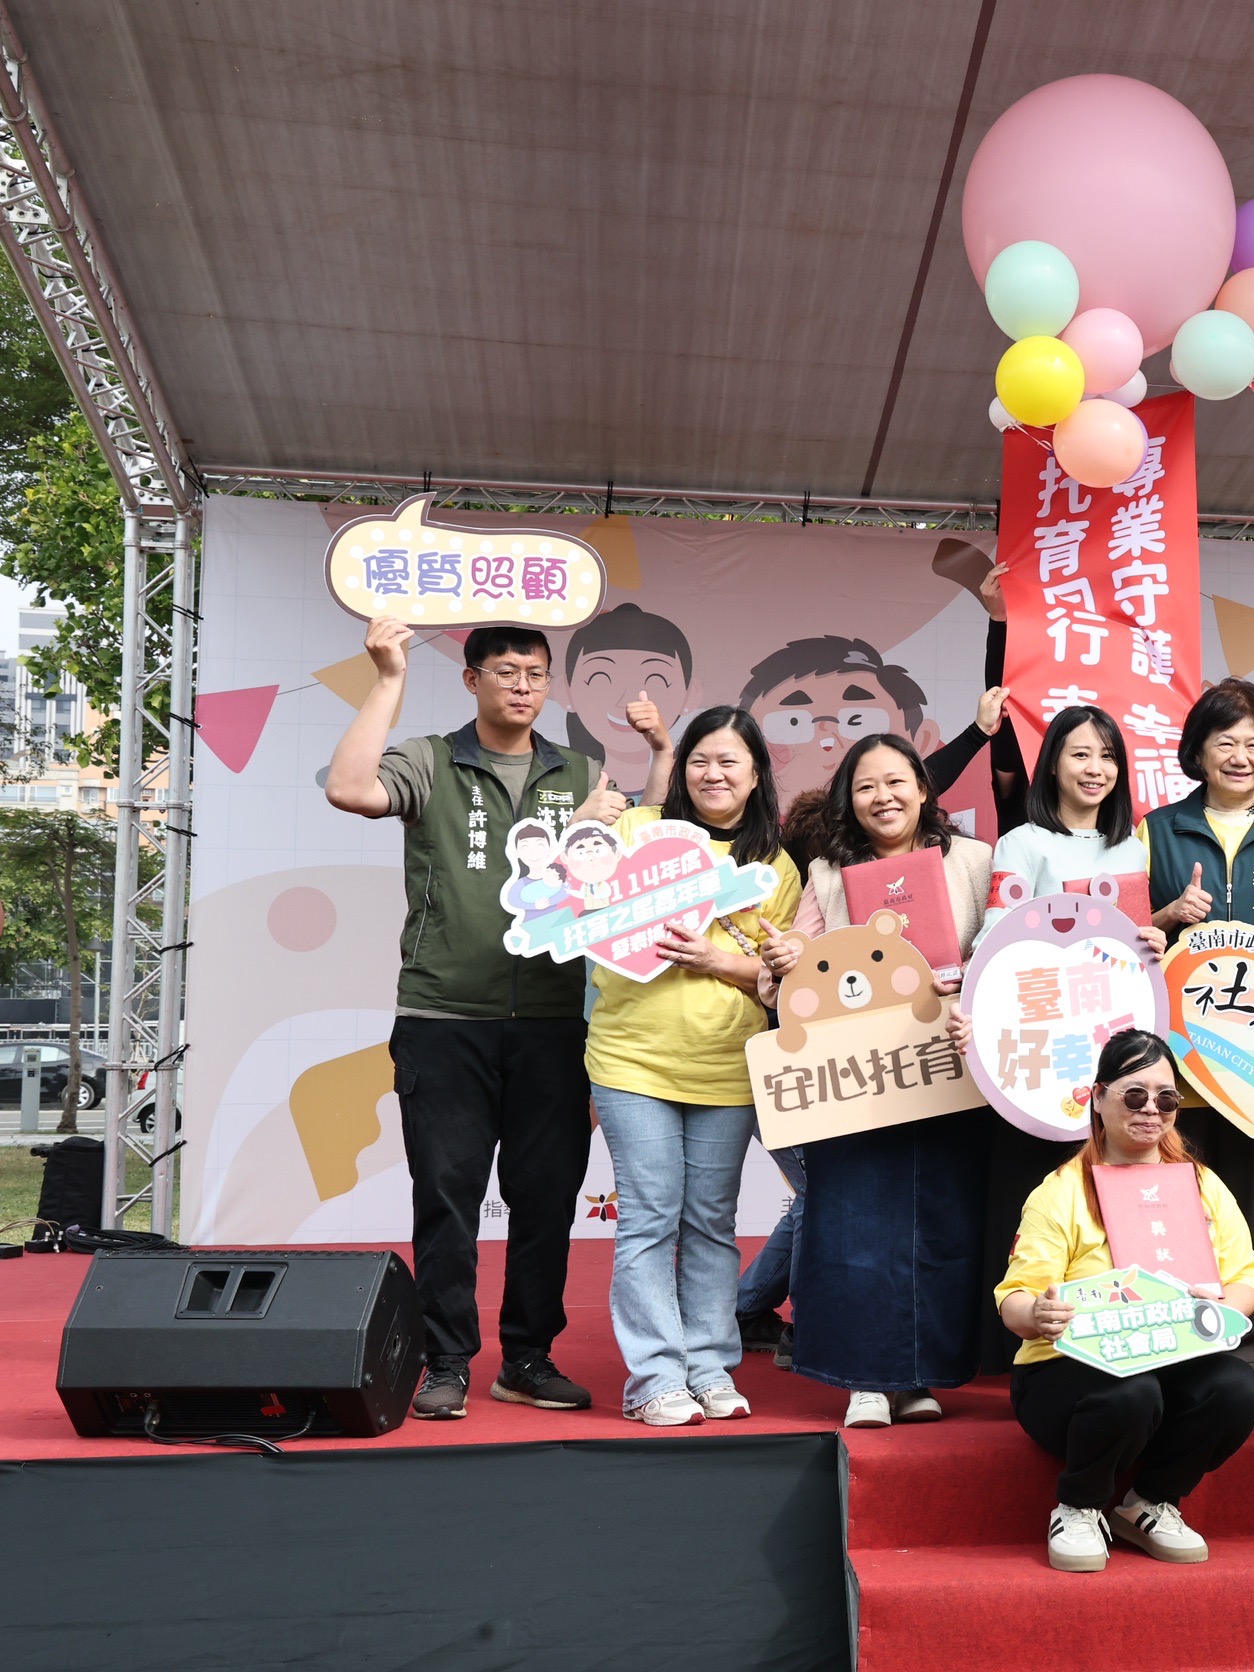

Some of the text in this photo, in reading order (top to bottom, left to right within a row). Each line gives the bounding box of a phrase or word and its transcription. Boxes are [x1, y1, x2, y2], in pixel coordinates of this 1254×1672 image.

[362, 549, 568, 601] 優質照顧
[467, 809, 488, 870] 許博維
[639, 824, 704, 844] 臺南市政府
[563, 869, 722, 951] 托育之星嘉年華
[1015, 962, 1113, 1024] 臺南
[1188, 1031, 1232, 1059] TAINAN
[763, 1035, 964, 1113] 安心托育
[1070, 1297, 1197, 1339] 臺南市政府
[1100, 1327, 1178, 1362] 社會局
